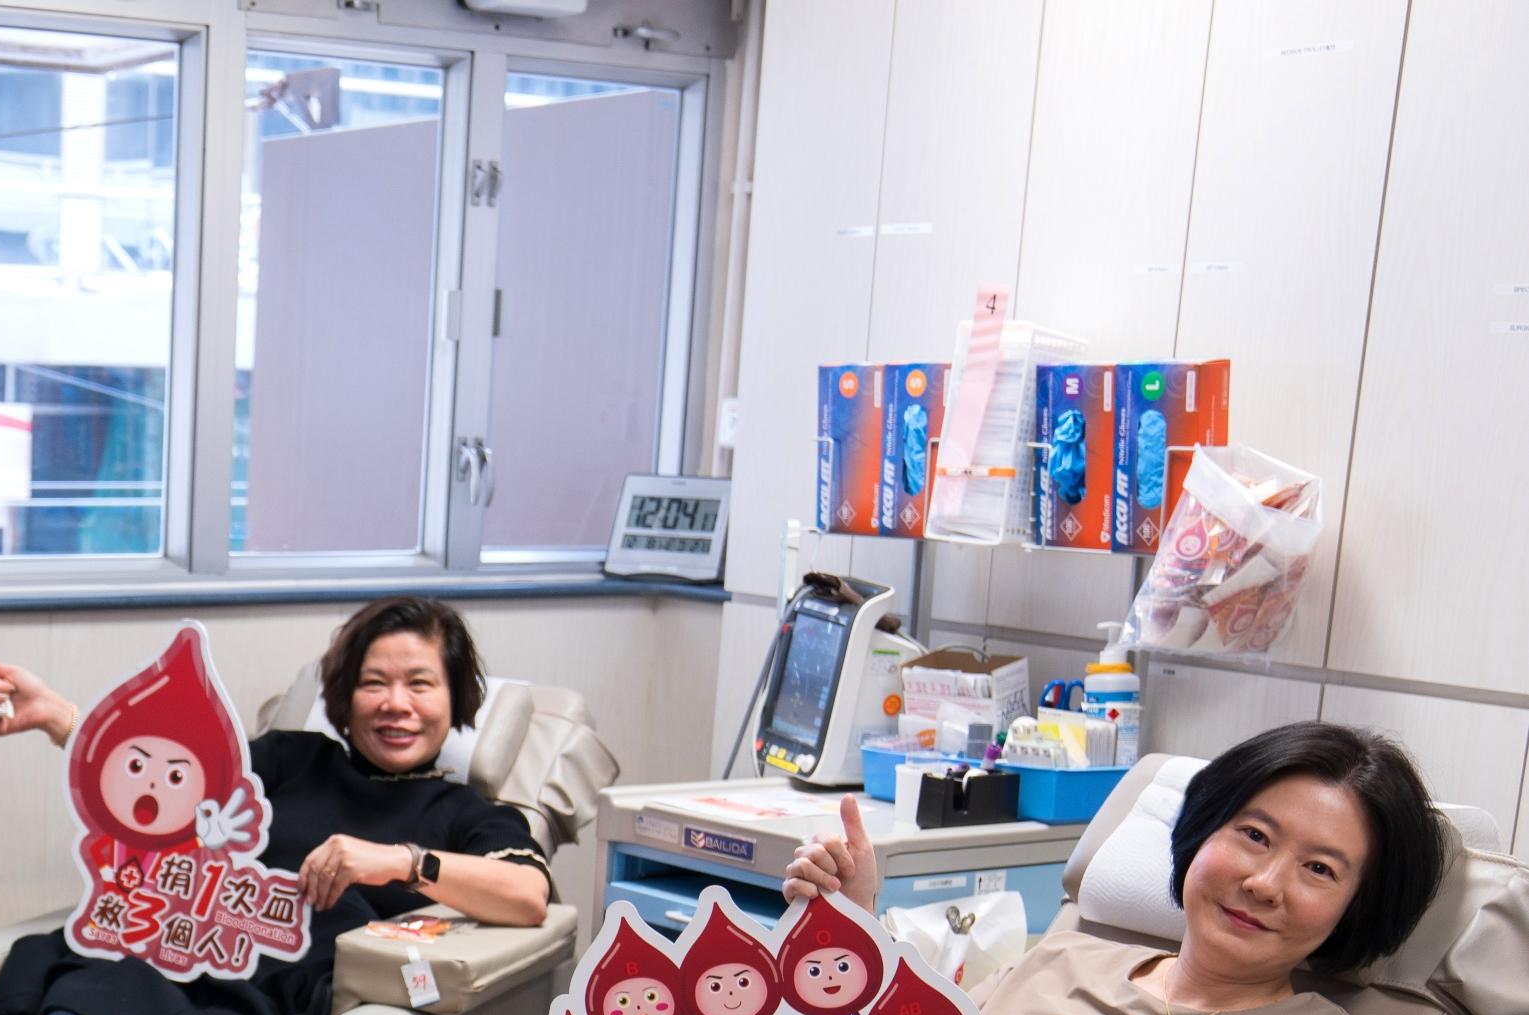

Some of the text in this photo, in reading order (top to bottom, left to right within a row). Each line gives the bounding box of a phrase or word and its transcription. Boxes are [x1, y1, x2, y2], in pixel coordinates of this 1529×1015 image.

[985, 294, 997, 315] 4
[1066, 377, 1079, 395] M
[1146, 380, 1160, 391] L
[883, 458, 896, 486] FIT
[1116, 468, 1129, 545] ACCU FIT
[705, 837, 748, 856] BAILIDA
[159, 856, 300, 924] 捐1次血
[816, 930, 832, 946] O
[626, 962, 639, 976] B
